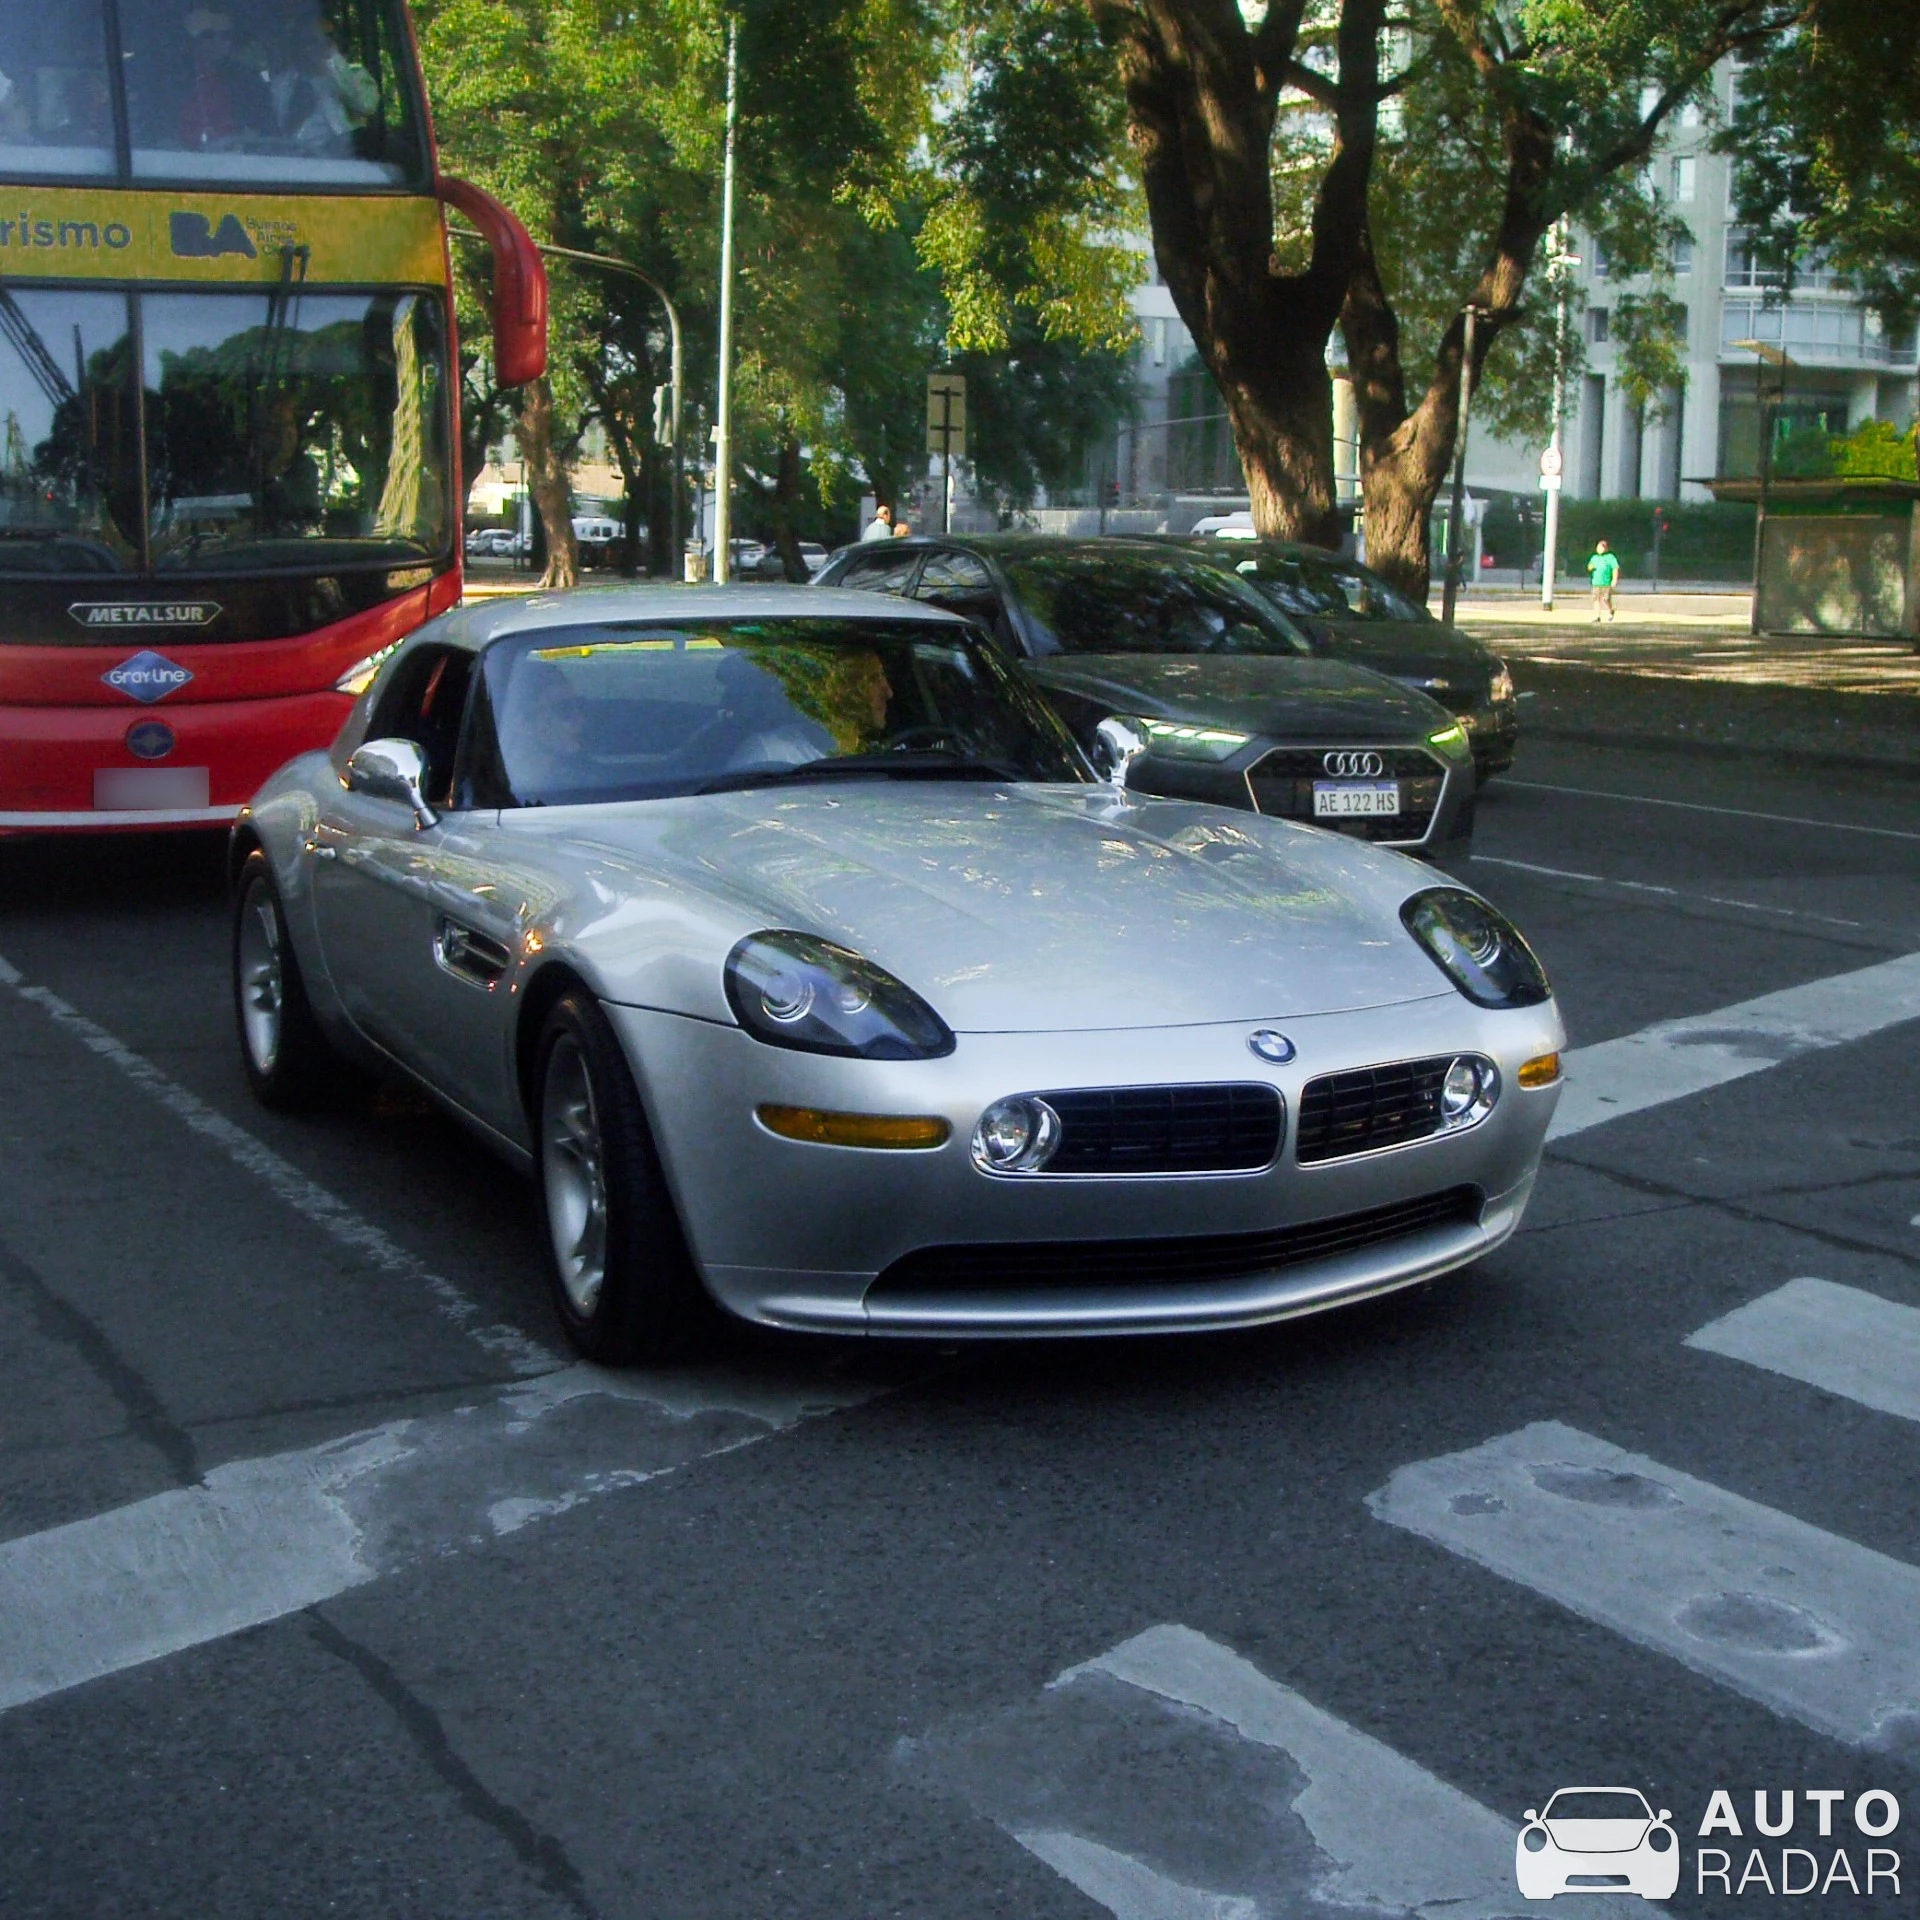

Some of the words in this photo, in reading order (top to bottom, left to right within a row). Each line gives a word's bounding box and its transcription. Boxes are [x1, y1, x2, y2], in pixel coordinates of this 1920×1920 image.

[0, 212, 132, 249] rismo
[169, 212, 257, 258] BA
[87, 606, 204, 623] METALSUR
[1319, 793, 1338, 813] AE
[1342, 793, 1372, 812] 122
[1376, 792, 1396, 812] HS
